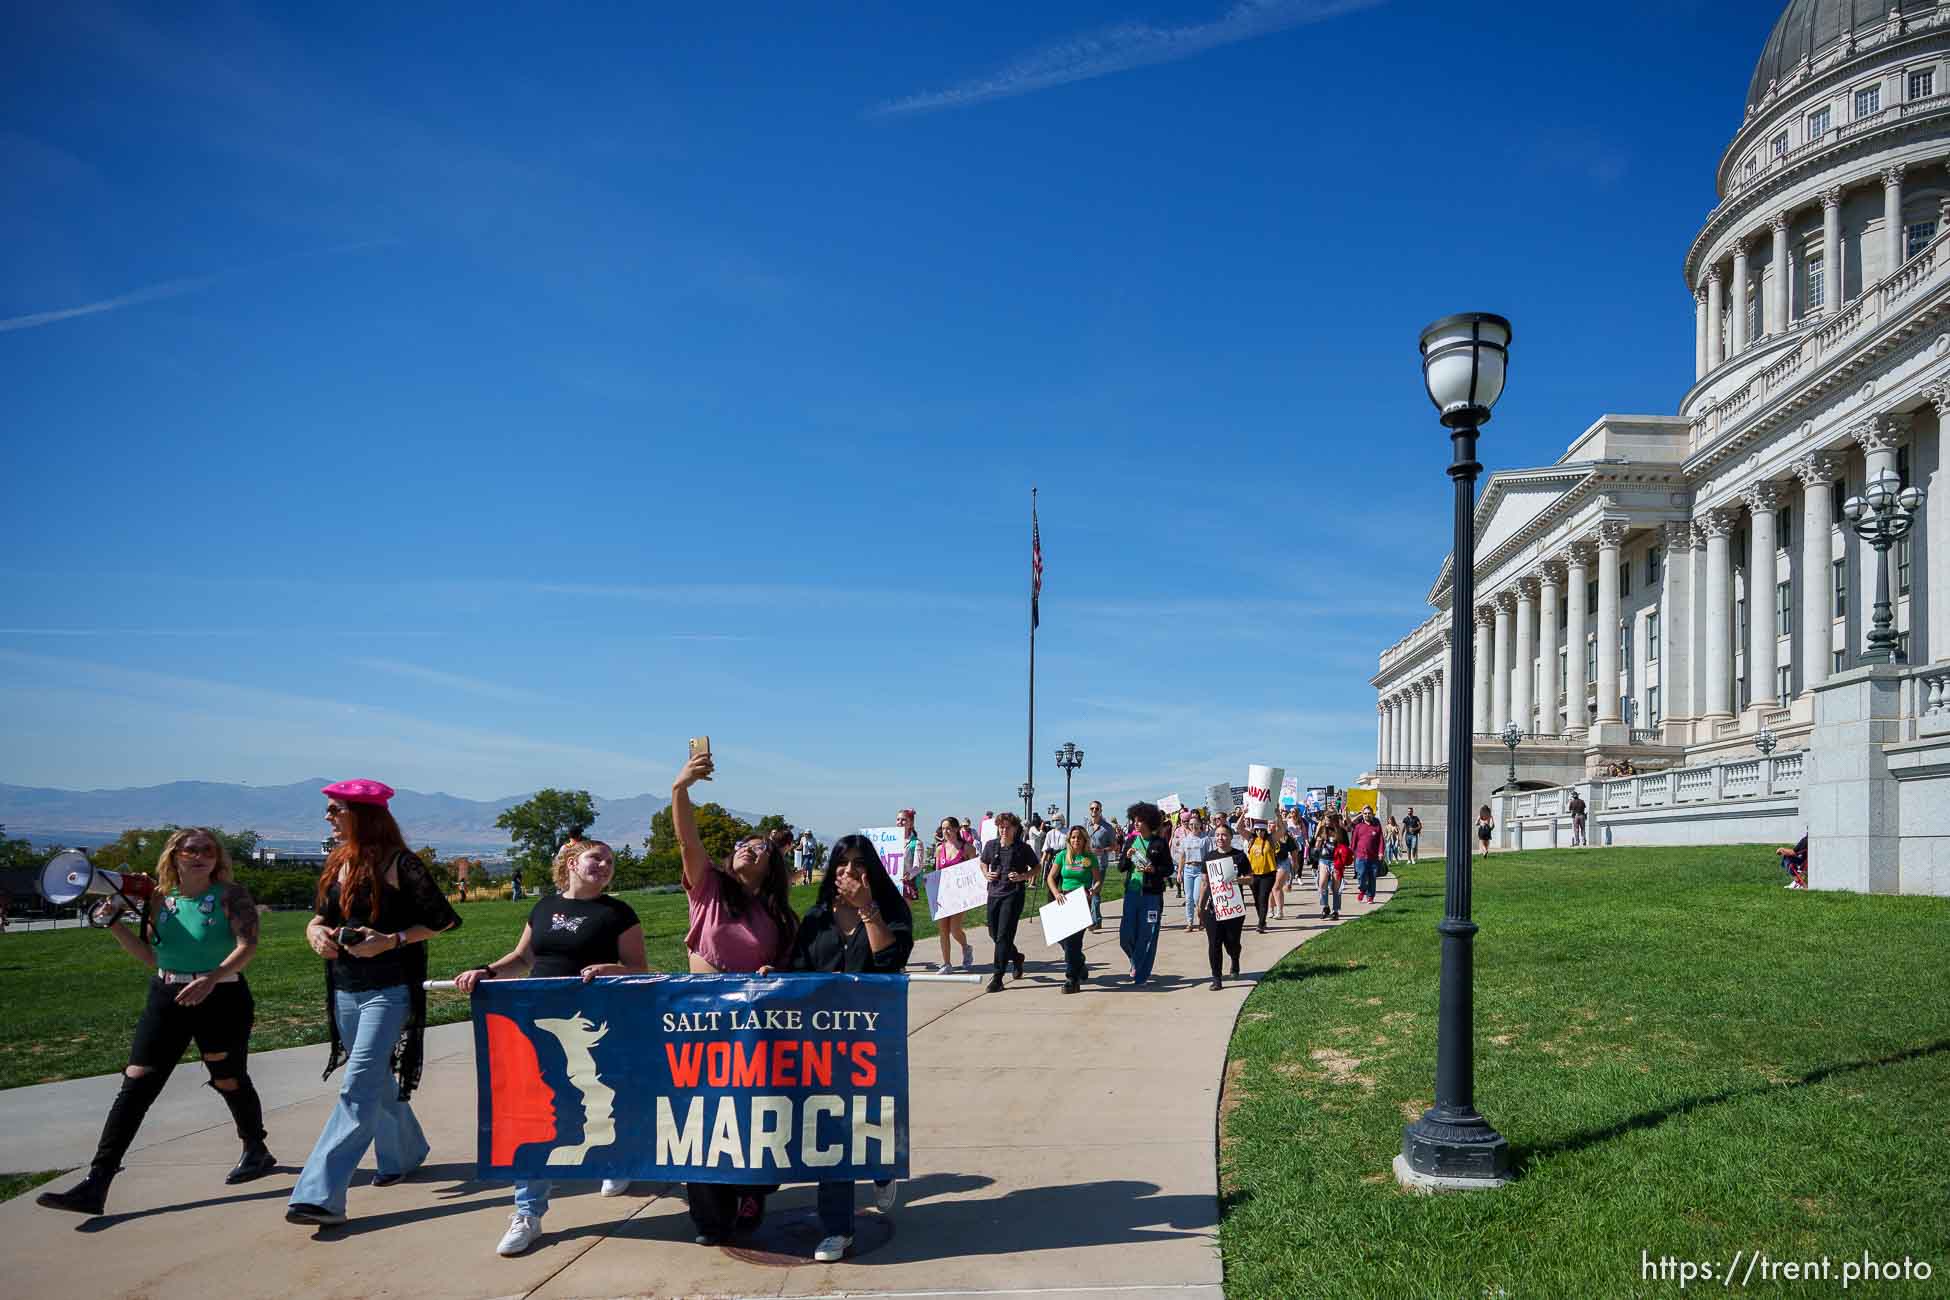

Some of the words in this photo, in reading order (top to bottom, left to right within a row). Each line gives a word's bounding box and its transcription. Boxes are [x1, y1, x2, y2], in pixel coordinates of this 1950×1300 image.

[880, 853, 904, 875] NT
[663, 1012, 721, 1033] SALT
[730, 1010, 802, 1031] LAKE
[812, 1010, 881, 1032] CITY
[665, 1040, 877, 1088] WOMEN'S
[656, 1095, 895, 1168] MARCH
